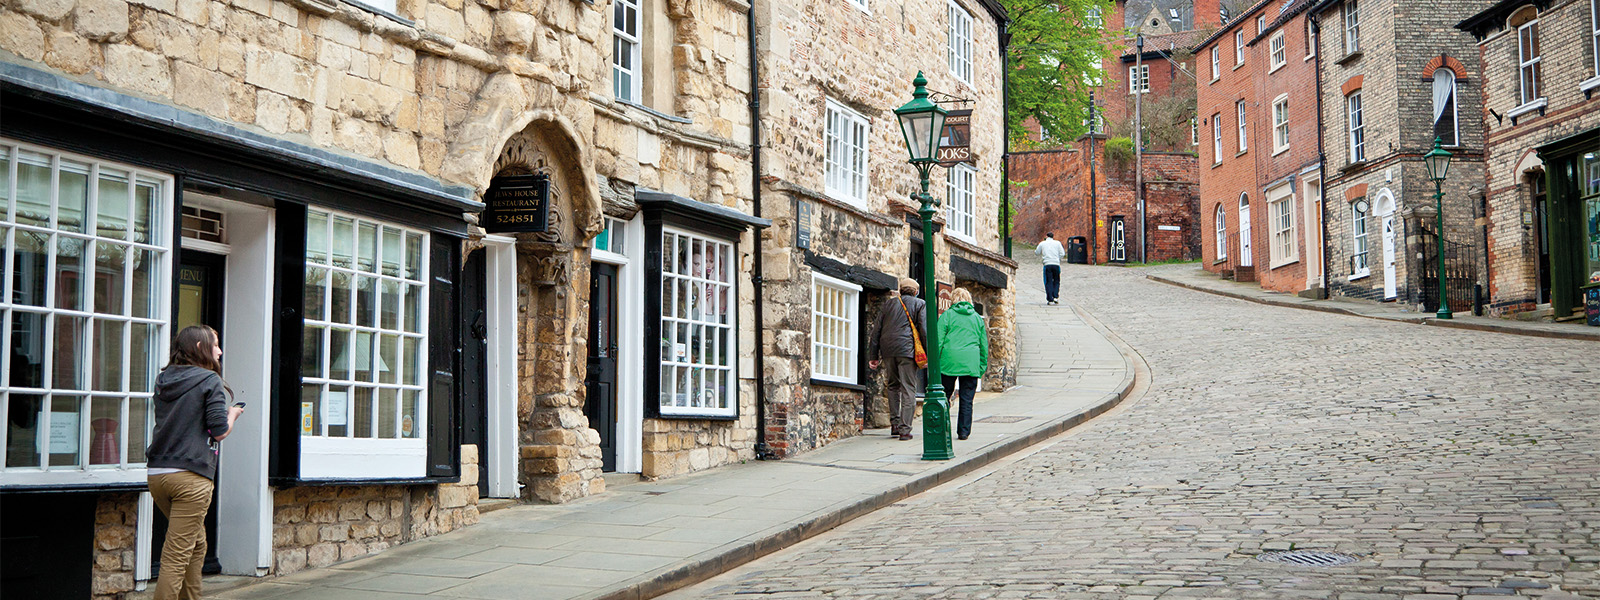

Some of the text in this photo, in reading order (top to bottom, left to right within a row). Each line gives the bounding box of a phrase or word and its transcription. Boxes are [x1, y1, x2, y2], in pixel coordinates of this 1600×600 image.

[936, 147, 969, 160] OOKS
[495, 189, 539, 198] JEWS HOUSE
[496, 214, 534, 223] 524851
